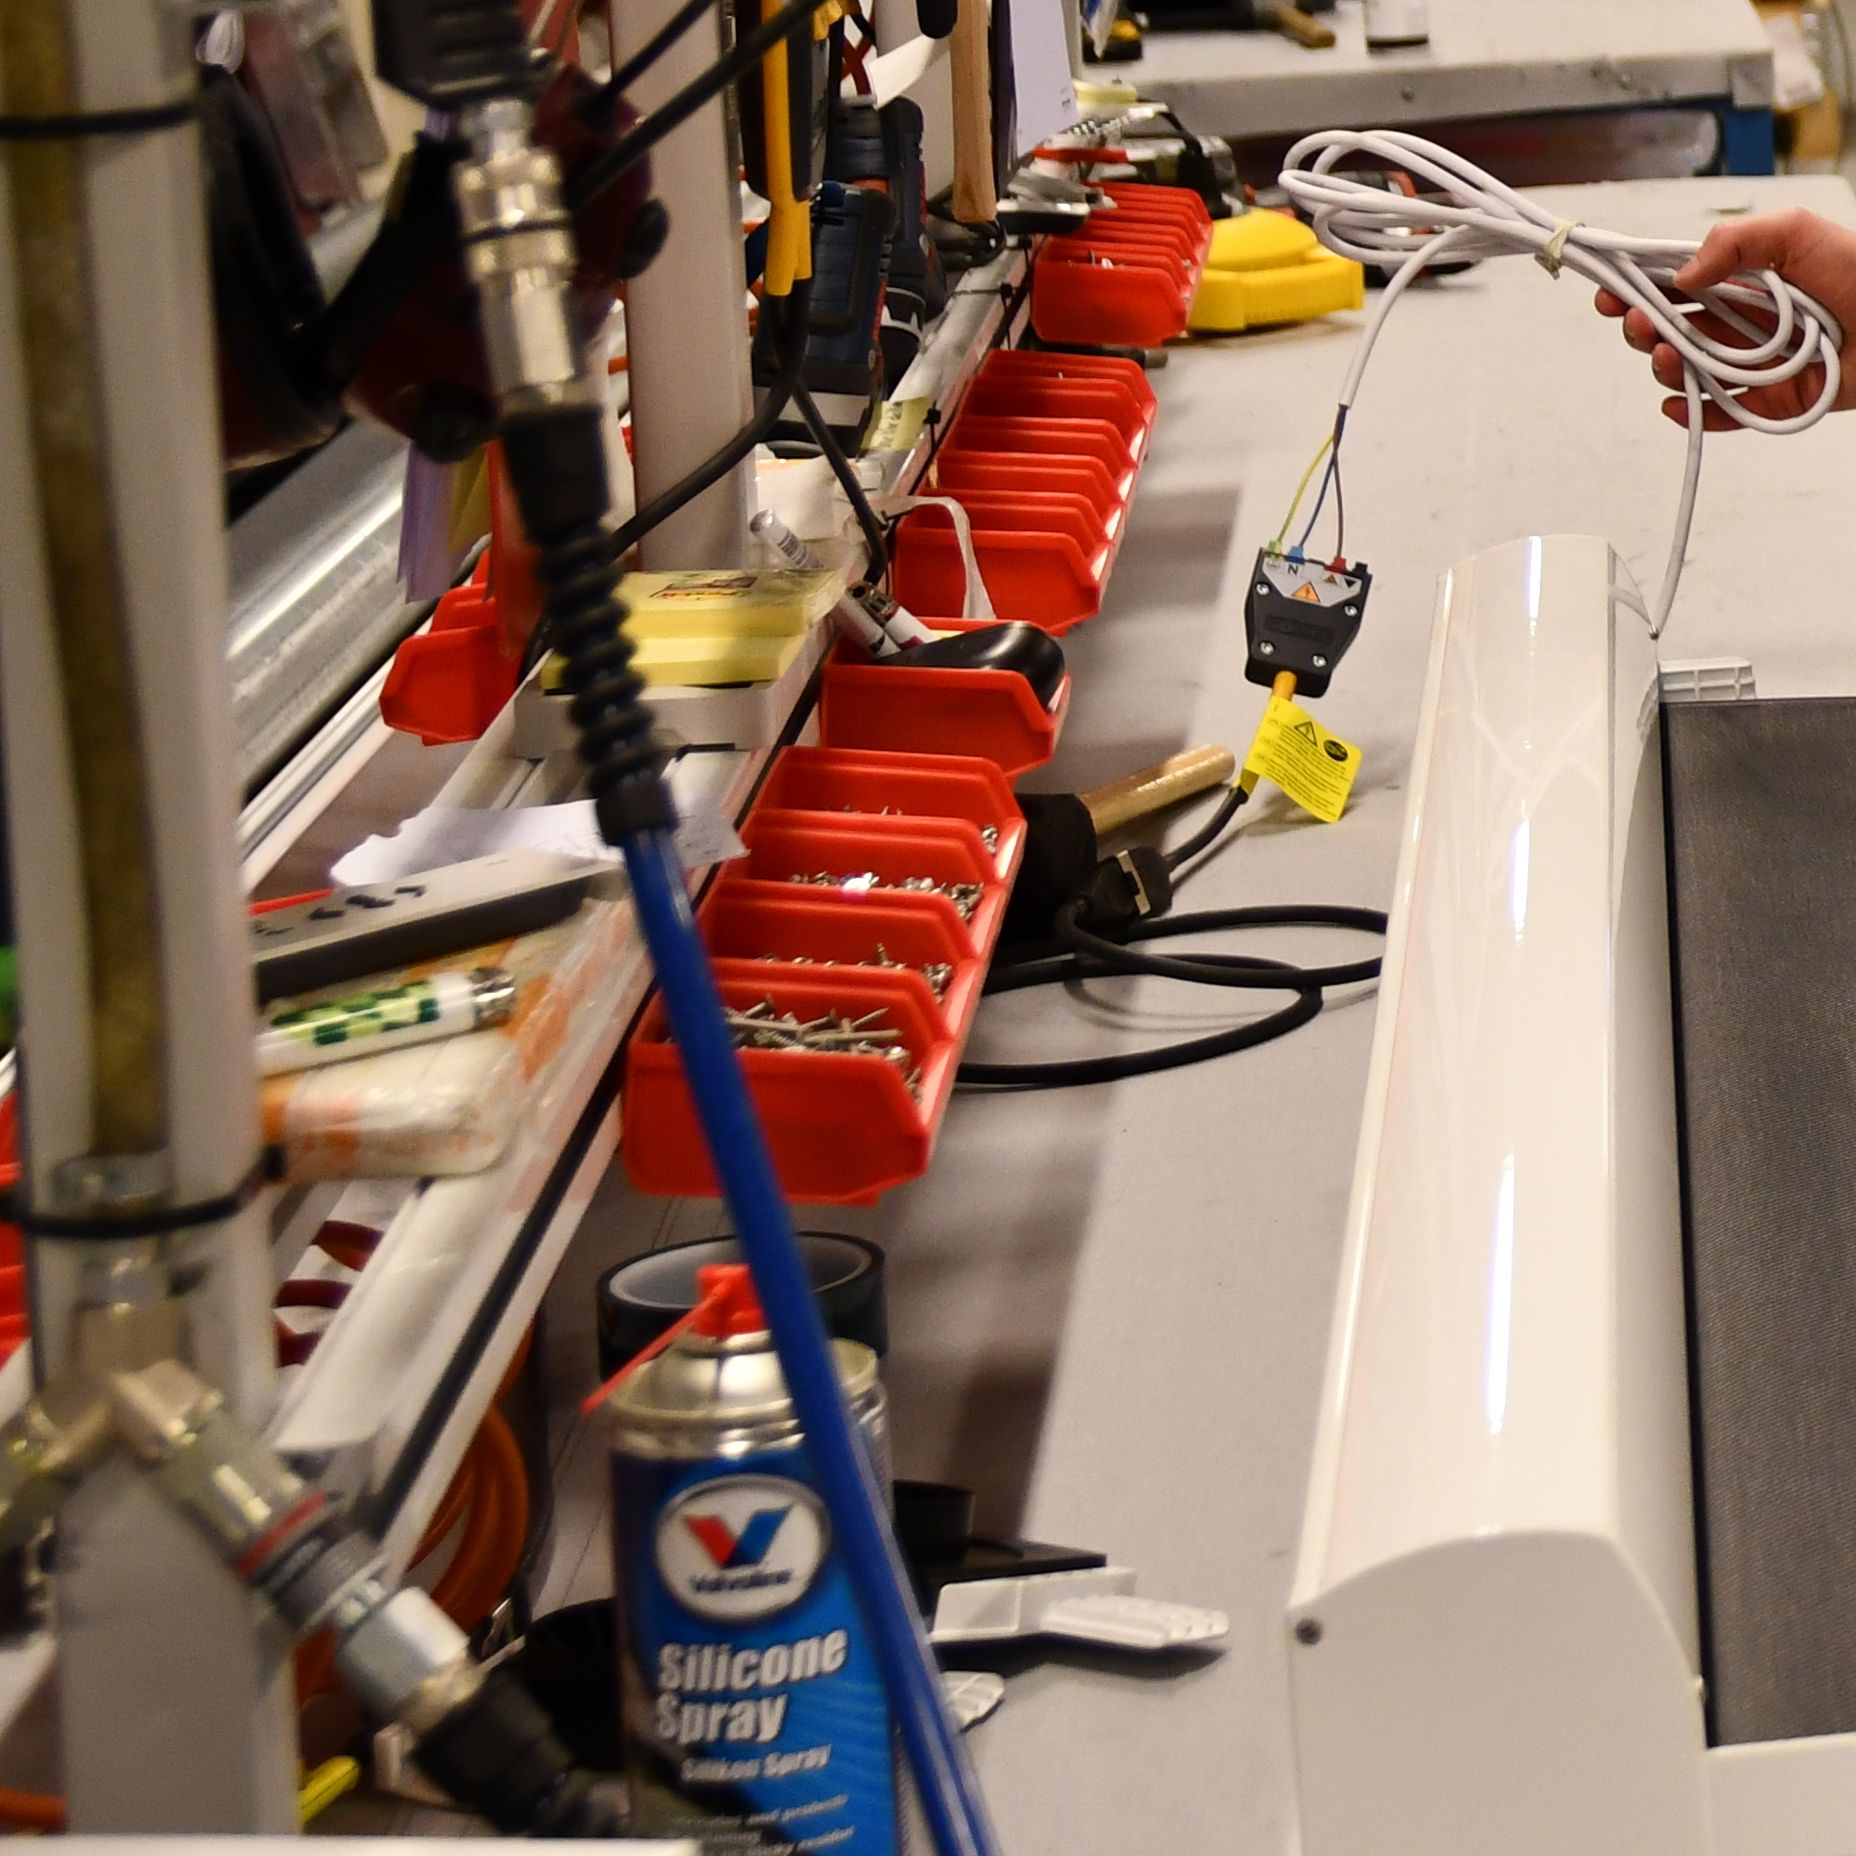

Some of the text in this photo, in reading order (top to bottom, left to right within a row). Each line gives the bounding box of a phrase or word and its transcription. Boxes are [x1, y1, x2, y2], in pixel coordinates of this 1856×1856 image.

[1287, 564, 1299, 575] N
[658, 1630, 848, 1691] Silicone
[656, 1694, 789, 1744] Spray
[764, 1744, 832, 1776] Spray
